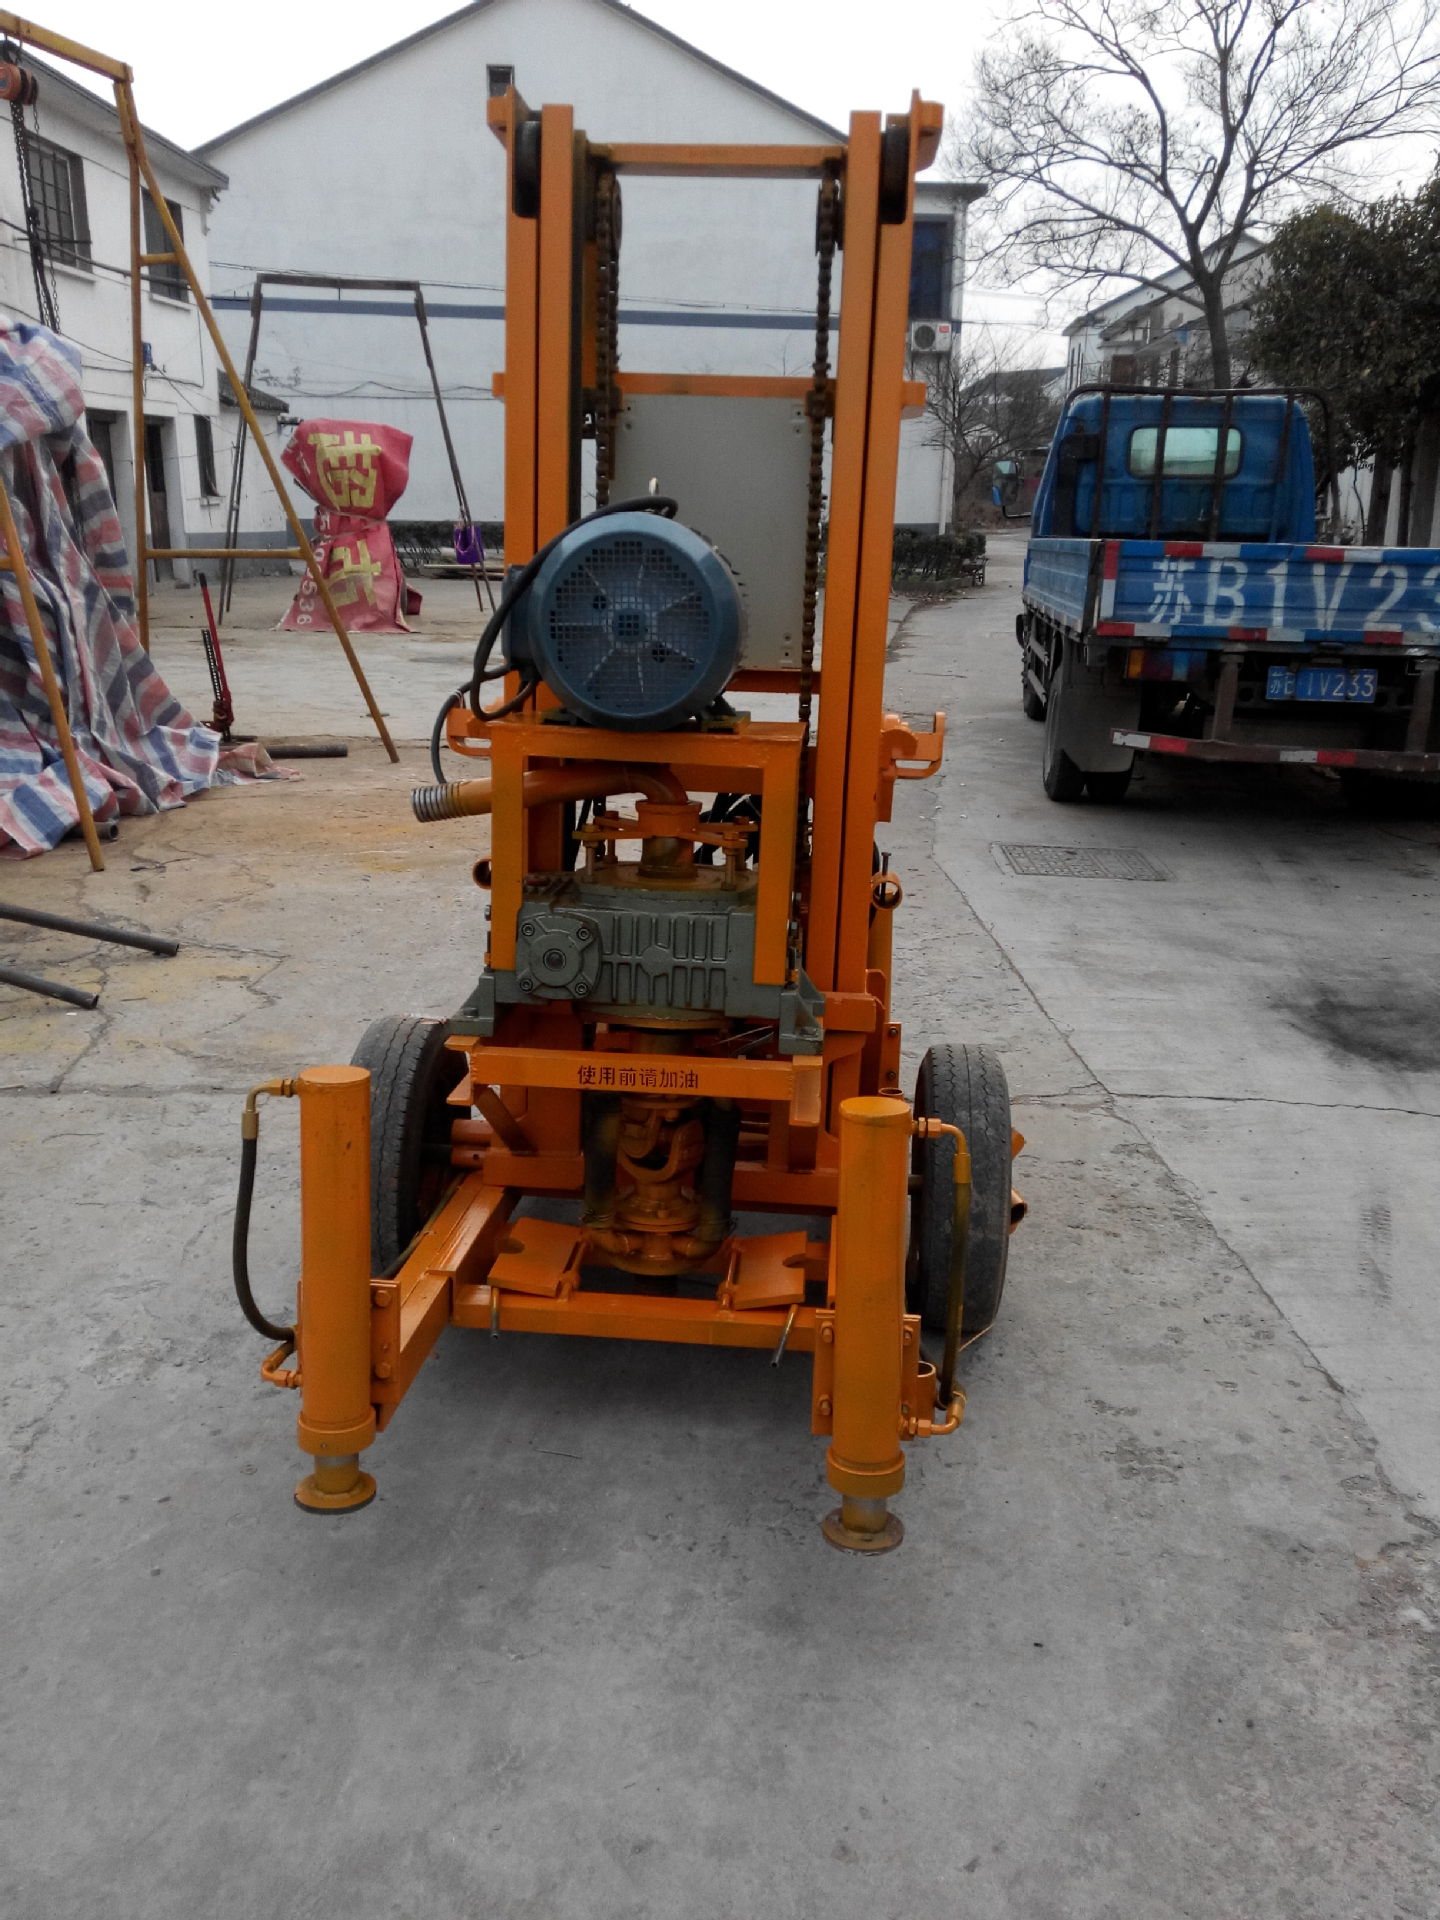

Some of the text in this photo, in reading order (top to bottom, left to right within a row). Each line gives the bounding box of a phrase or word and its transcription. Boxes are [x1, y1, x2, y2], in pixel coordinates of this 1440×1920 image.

[577, 1065, 699, 1089] 使用前请加油
